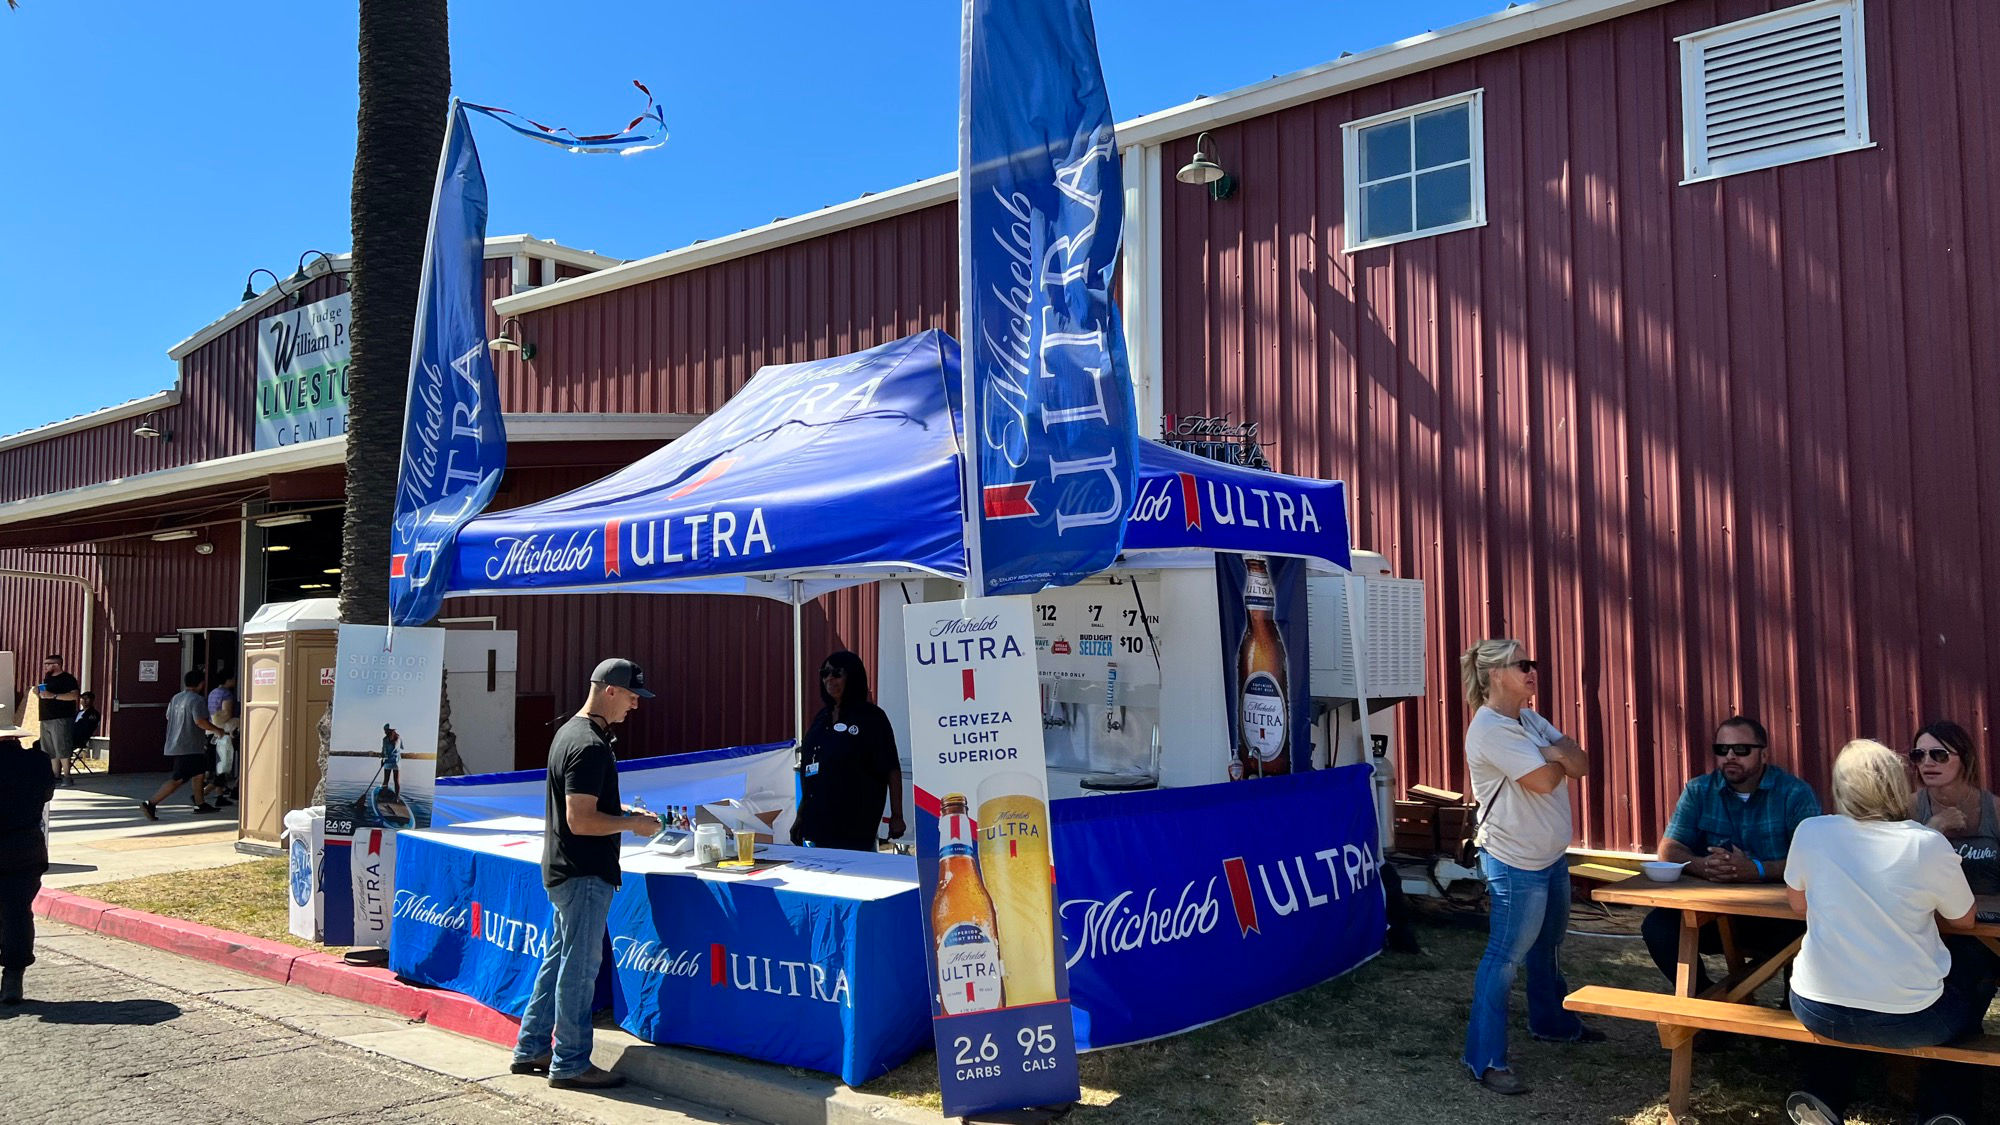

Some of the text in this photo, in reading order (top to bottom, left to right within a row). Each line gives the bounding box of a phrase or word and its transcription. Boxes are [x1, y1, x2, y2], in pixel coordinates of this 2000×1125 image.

[312, 307, 342, 326] Judge
[983, 185, 1035, 468] Michelob
[270, 311, 344, 376] William P.
[1039, 135, 1123, 537] ULTRA
[263, 364, 351, 417] LIVESTO
[278, 414, 348, 446] CENTE
[396, 356, 443, 545] Michelob
[409, 339, 485, 594] ULTRA
[1207, 480, 1320, 533] ULTRA
[485, 507, 773, 580] Michelob ULTRA
[1036, 605, 1057, 621] $12
[1088, 605, 1102, 621] $7
[1122, 610, 1138, 627] $7
[929, 615, 999, 637] Michelob
[916, 635, 1022, 665] ULTRA
[1079, 641, 1113, 656] SELTZER
[1120, 637, 1143, 653] $10
[349, 654, 428, 667] SUPERIOR
[349, 669, 425, 681] OUTDOOR
[366, 685, 405, 696] BEER
[938, 711, 1013, 728] CERVEZA
[1244, 711, 1283, 727] ULTRA
[953, 730, 999, 745] LIGHT
[938, 747, 1018, 764] SUPERIOR
[340, 821, 352, 830] 95
[986, 822, 1039, 840] ULTRA
[367, 863, 384, 931] ULTRA
[1059, 841, 1375, 970] Michelob ULTRA
[393, 889, 468, 930] Michelob
[484, 910, 549, 960] ULTRA
[947, 951, 987, 965] Michelob
[612, 936, 851, 1008] Michelob ULTRA
[942, 962, 997, 982] ULTRA
[953, 1025, 1056, 1065] 2.6 95
[956, 1058, 1057, 1081] CARBS CALS
